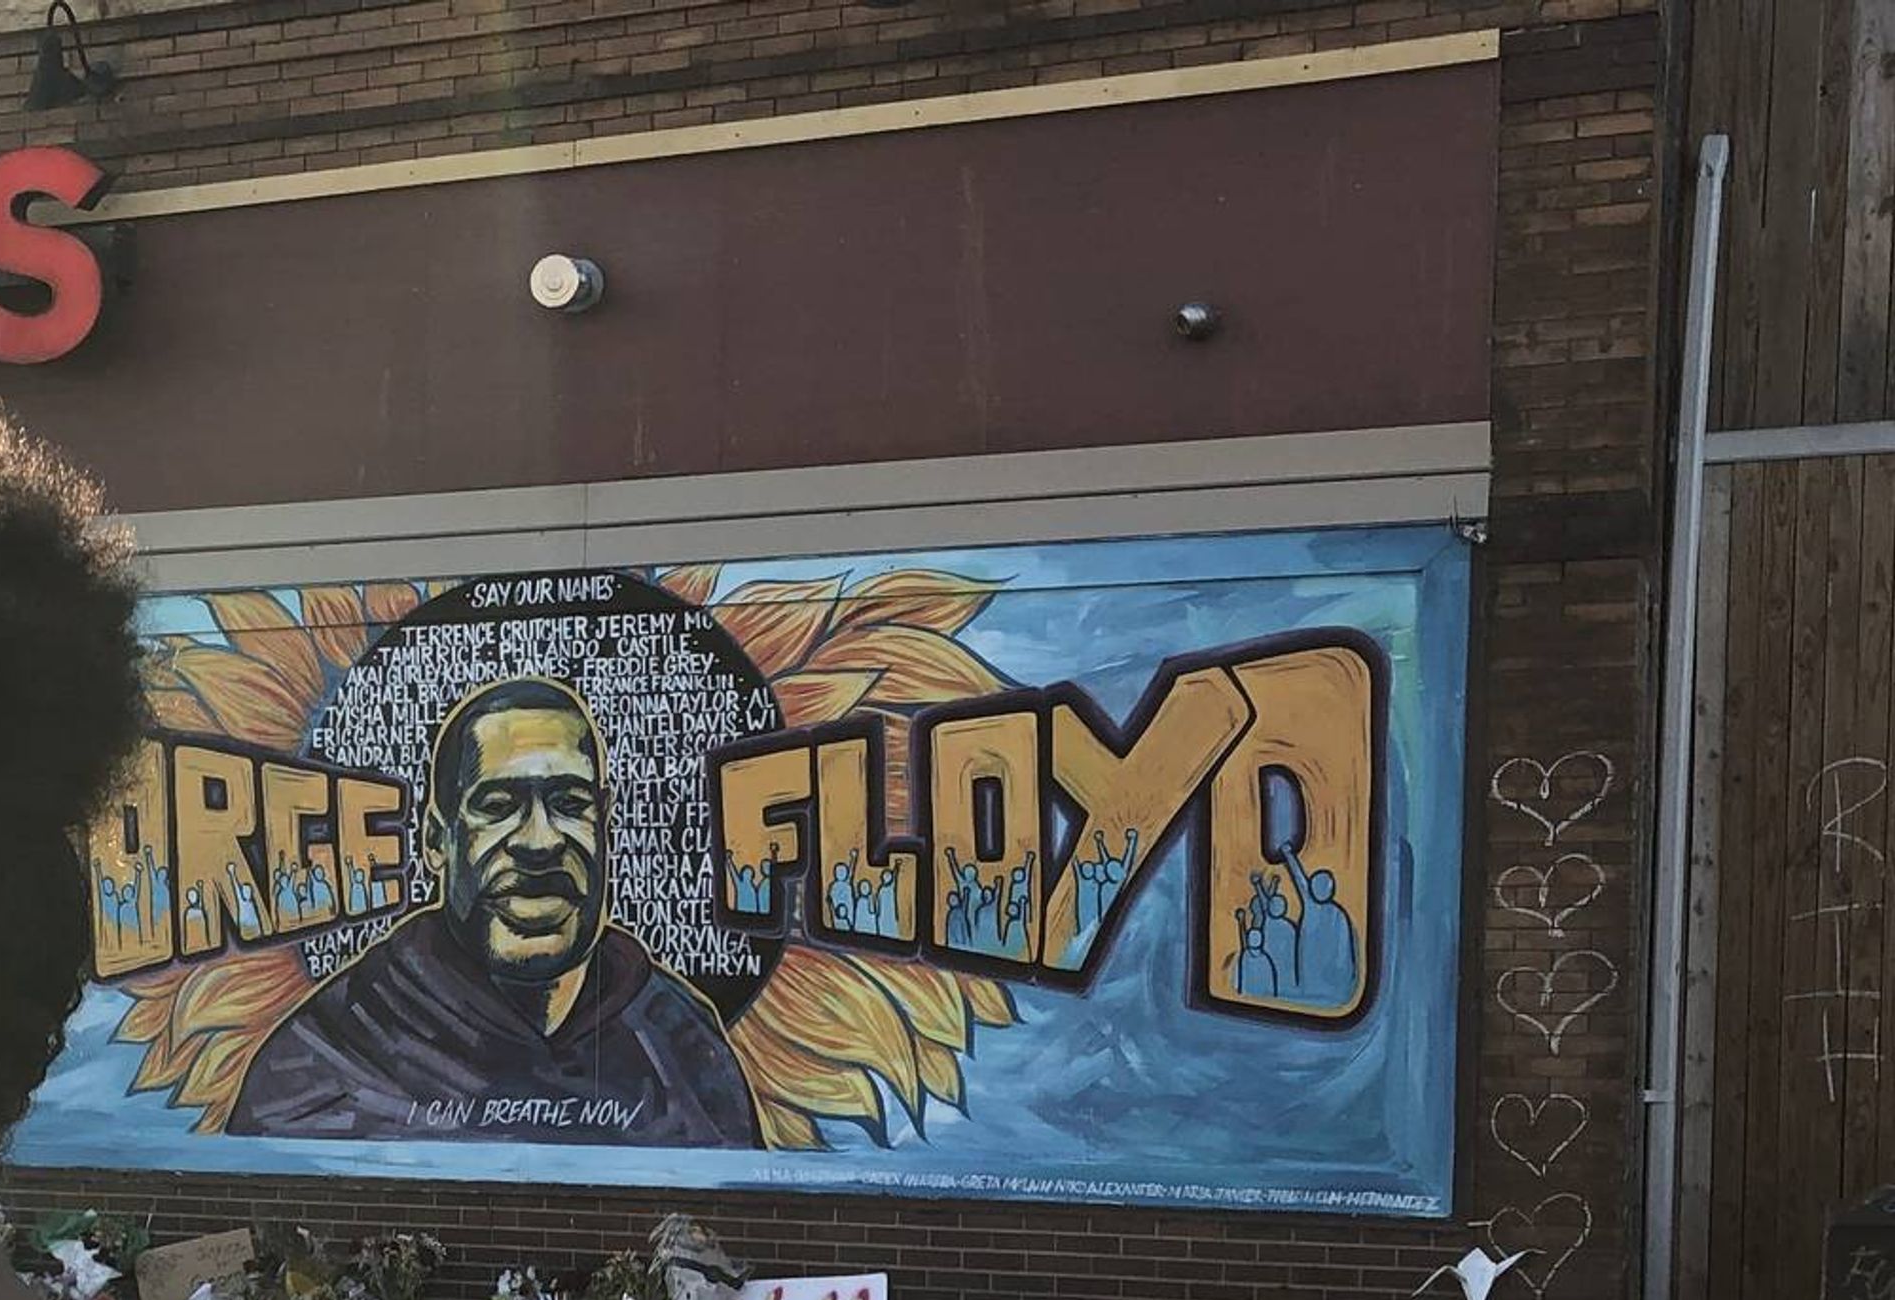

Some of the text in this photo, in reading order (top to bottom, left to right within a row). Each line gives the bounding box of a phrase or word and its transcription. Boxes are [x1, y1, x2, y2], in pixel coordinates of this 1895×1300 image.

[471, 574, 616, 608] SAY OUR NAMES
[401, 621, 496, 648] TERRENCE
[500, 615, 589, 644] CRUTCHER
[595, 612, 676, 640] JEREMY
[499, 640, 600, 662] PHILANDO
[617, 633, 692, 656] CASTILE
[346, 664, 383, 687] AKAI
[511, 657, 571, 680] JAMES
[583, 656, 661, 678] FREDDIE
[664, 651, 715, 675] GREY
[336, 684, 413, 706] MICHAEL
[574, 673, 735, 695] TERRANCE FRANKLIN
[324, 702, 448, 729] TYISHA MILLE
[588, 694, 670, 717] BREONNA
[670, 690, 739, 714] TAYLOR
[312, 725, 428, 749] ERIC GARNER
[597, 714, 681, 738] SHANTEL
[683, 711, 738, 735] DAVIS
[325, 744, 395, 768] SANDRA
[607, 755, 658, 780] REKIA
[610, 801, 679, 828] SHELLY
[90, 645, 1375, 1013] ORGE FLOYD
[609, 827, 676, 854] JAMAR
[609, 854, 693, 879] TANISHA
[609, 877, 682, 901] TARIKA
[610, 899, 712, 926] ALTON STE
[661, 953, 762, 977] KATHRYN
[407, 1093, 649, 1132] I CAN BREATHE NOW
